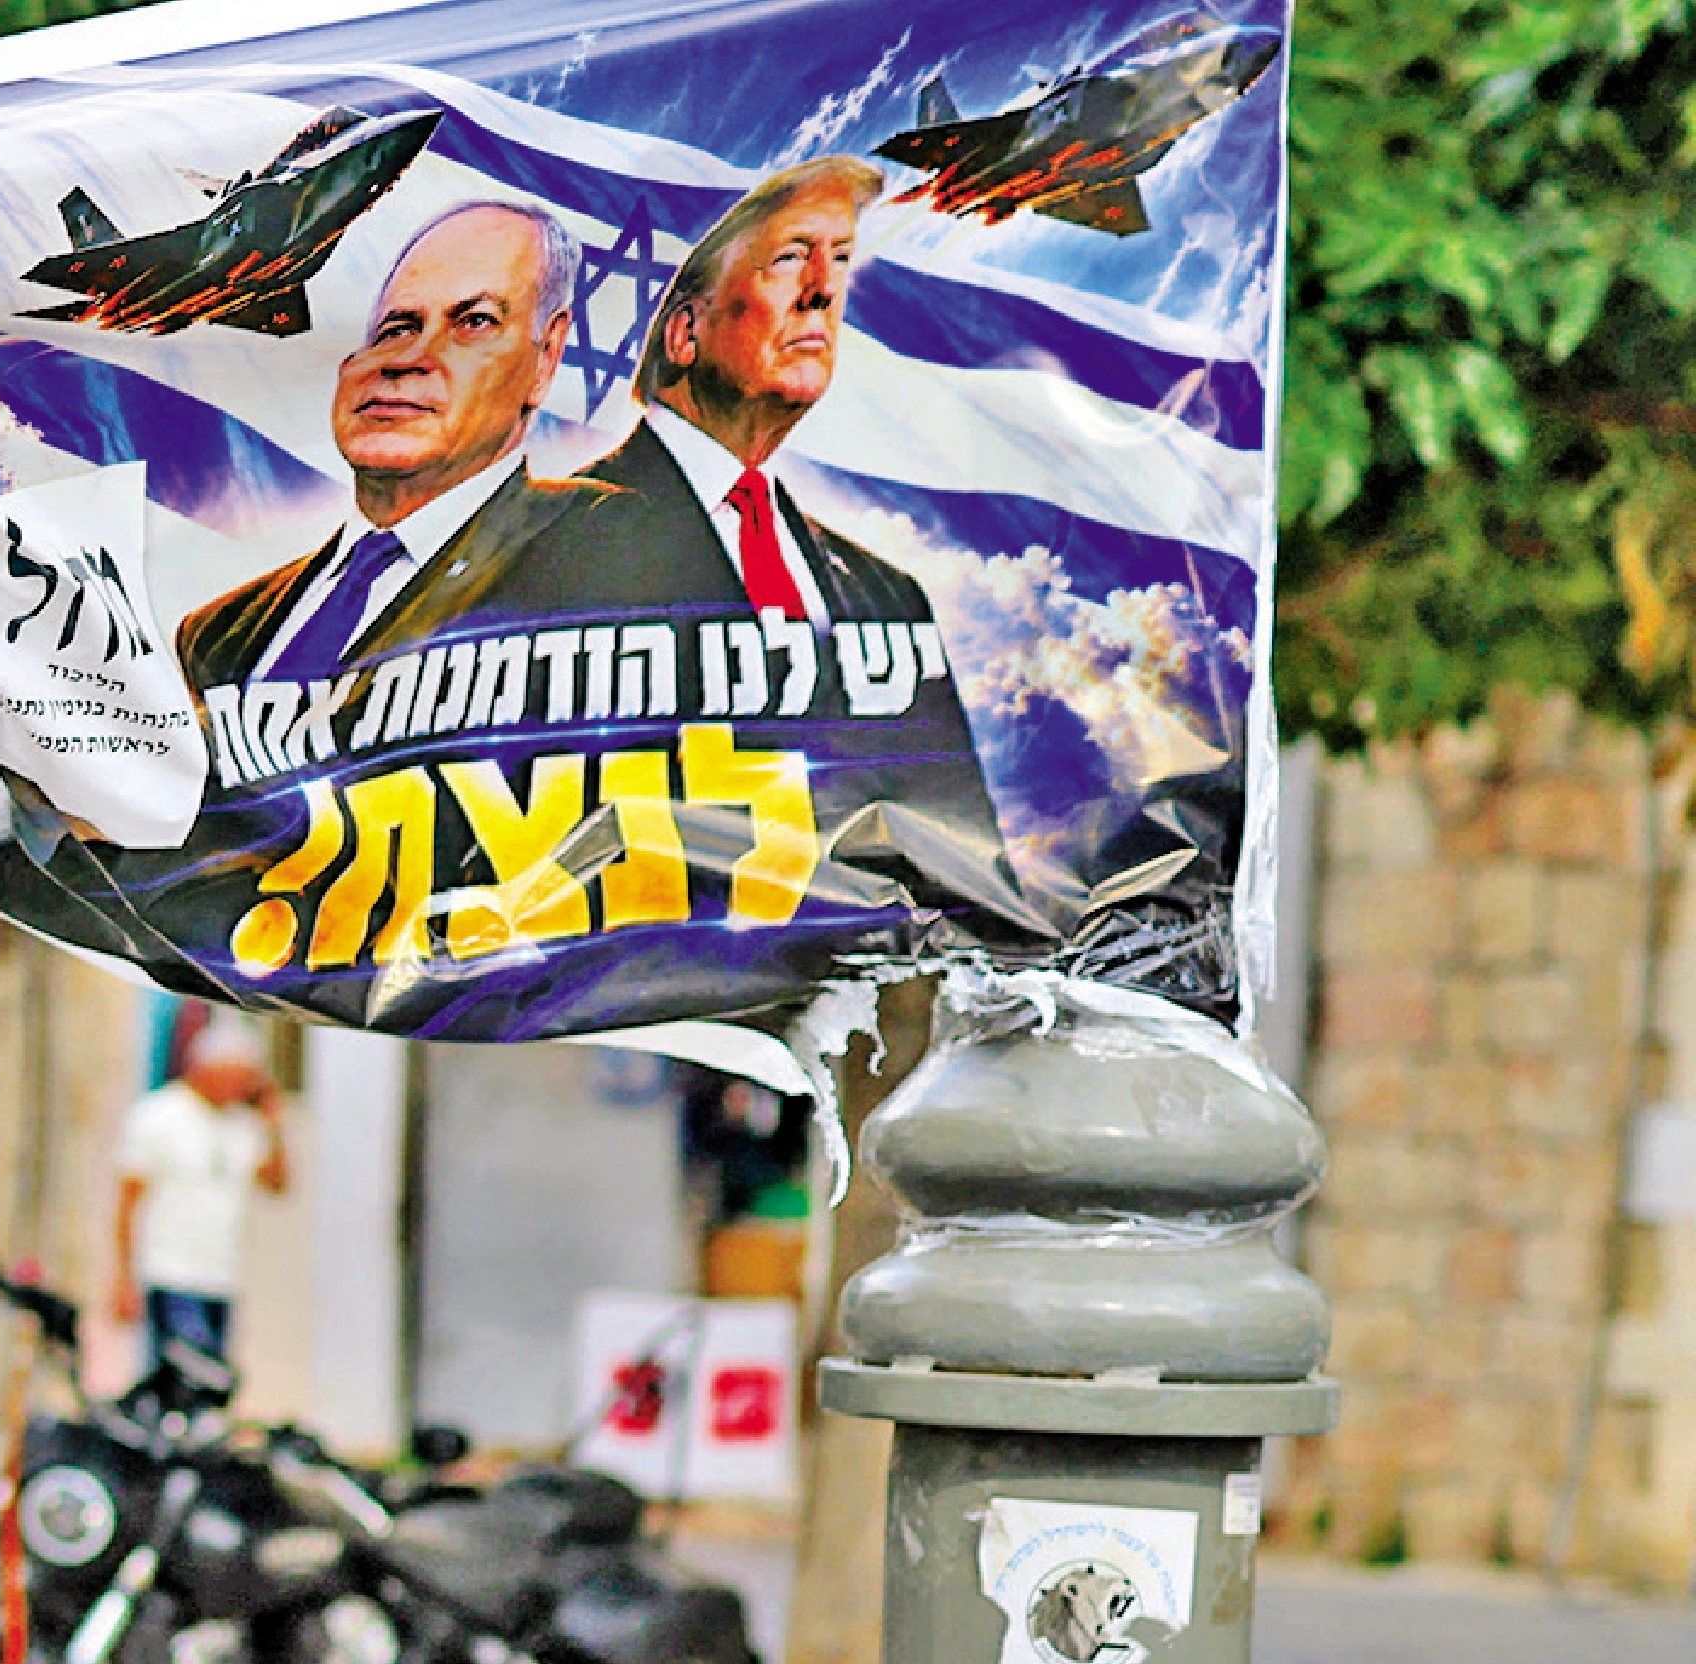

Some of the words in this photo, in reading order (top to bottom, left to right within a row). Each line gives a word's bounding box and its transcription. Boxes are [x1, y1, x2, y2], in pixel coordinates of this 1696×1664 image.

[46, 662, 126, 694] הליכוד
[353, 619, 675, 750] הזדמנות
[698, 606, 819, 716] לנו
[835, 620, 946, 716] יש
[204, 672, 359, 789] אחת
[231, 724, 822, 978] לנצח!
